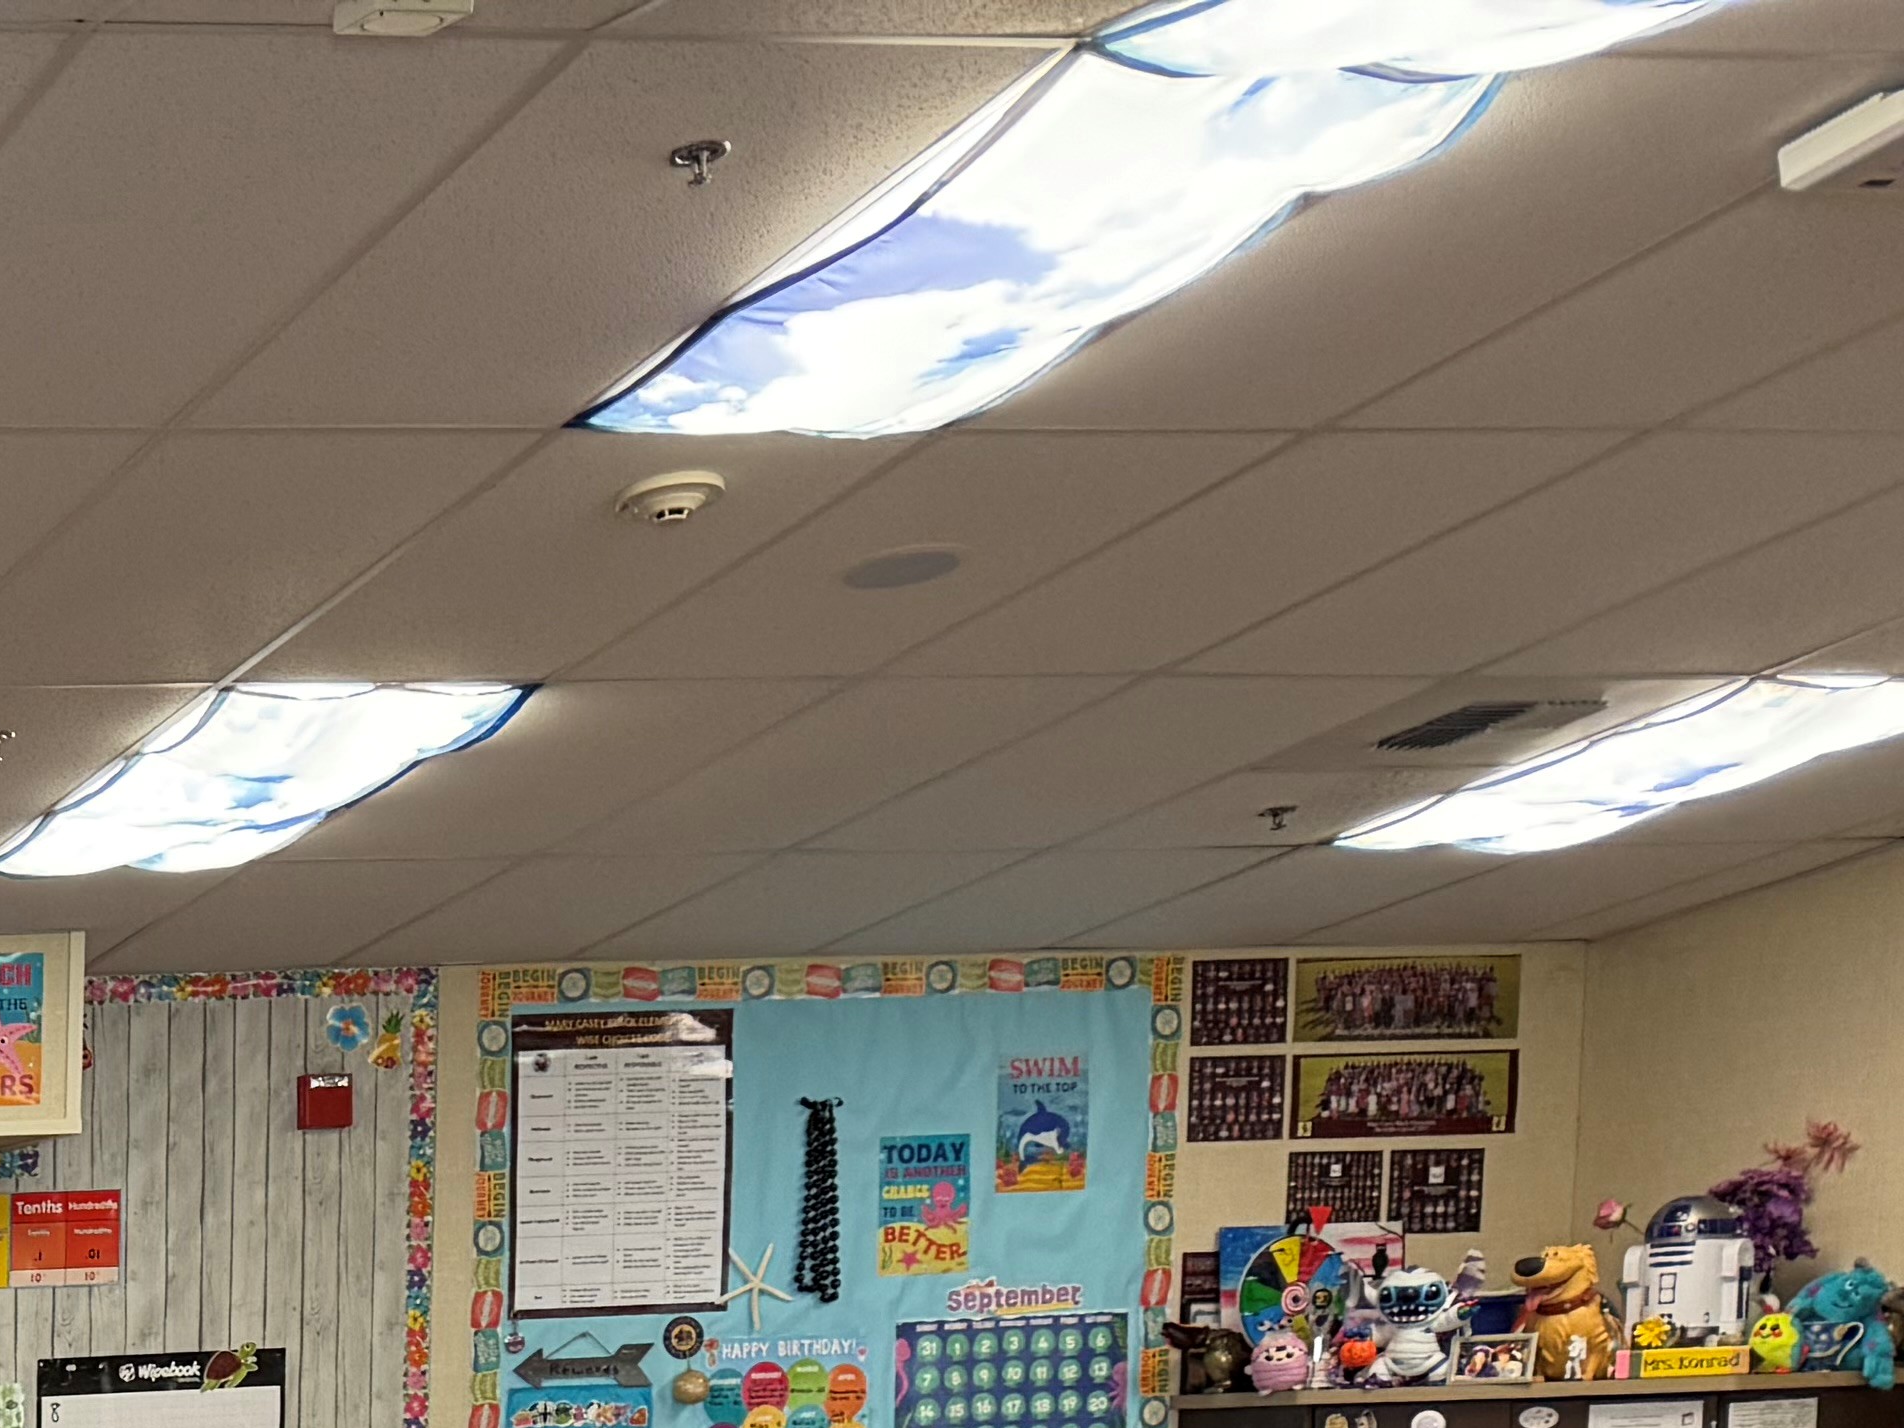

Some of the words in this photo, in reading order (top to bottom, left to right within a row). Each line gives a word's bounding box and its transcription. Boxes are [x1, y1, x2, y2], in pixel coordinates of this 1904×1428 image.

[698, 966, 741, 980] BEGIN
[882, 960, 925, 975] BEGIN
[1061, 957, 1105, 971] BEGIN
[511, 969, 556, 983] BEGIN
[1009, 1056, 1081, 1080] SWIM
[1013, 1083, 1028, 1095] TO
[1030, 1082, 1052, 1094] THE
[1055, 1081, 1078, 1093] TOP
[882, 1141, 965, 1165] TODAY
[884, 1167, 900, 1180] IS
[903, 1164, 967, 1180] ANOTHER
[882, 1184, 930, 1200] CHANCE
[16, 1199, 63, 1216] Tenths
[883, 1206, 897, 1218] TO
[900, 1205, 915, 1218] BE
[883, 1225, 968, 1262] BETTER
[947, 1284, 1082, 1313] September
[721, 1342, 770, 1360] HAPPY
[777, 1338, 858, 1357] BIRTHDAY!
[922, 1341, 937, 1355] 31
[955, 1343, 960, 1354] 1
[982, 1340, 990, 1353] 2
[1010, 1336, 1019, 1349] 3
[1038, 1336, 1049, 1348] 4
[1066, 1335, 1075, 1349] 5
[1096, 1334, 1105, 1346] 6
[138, 1360, 201, 1381] Wipebook
[548, 1360, 620, 1376] Rewards
[1643, 1356, 1675, 1373] Mrs.
[1677, 1353, 1742, 1370] Konrad
[922, 1374, 931, 1387] 7
[981, 1369, 989, 1382] 9
[1007, 1367, 1022, 1380] 10
[1037, 1366, 1048, 1379] 11
[1063, 1365, 1078, 1378] 12
[1093, 1362, 1108, 1376] 13
[918, 1405, 934, 1418] 14
[948, 1404, 964, 1417] 15
[977, 1401, 991, 1414] 16
[1006, 1400, 1021, 1413] 17
[1063, 1397, 1076, 1410] 19
[1090, 1396, 1107, 1410] 20
